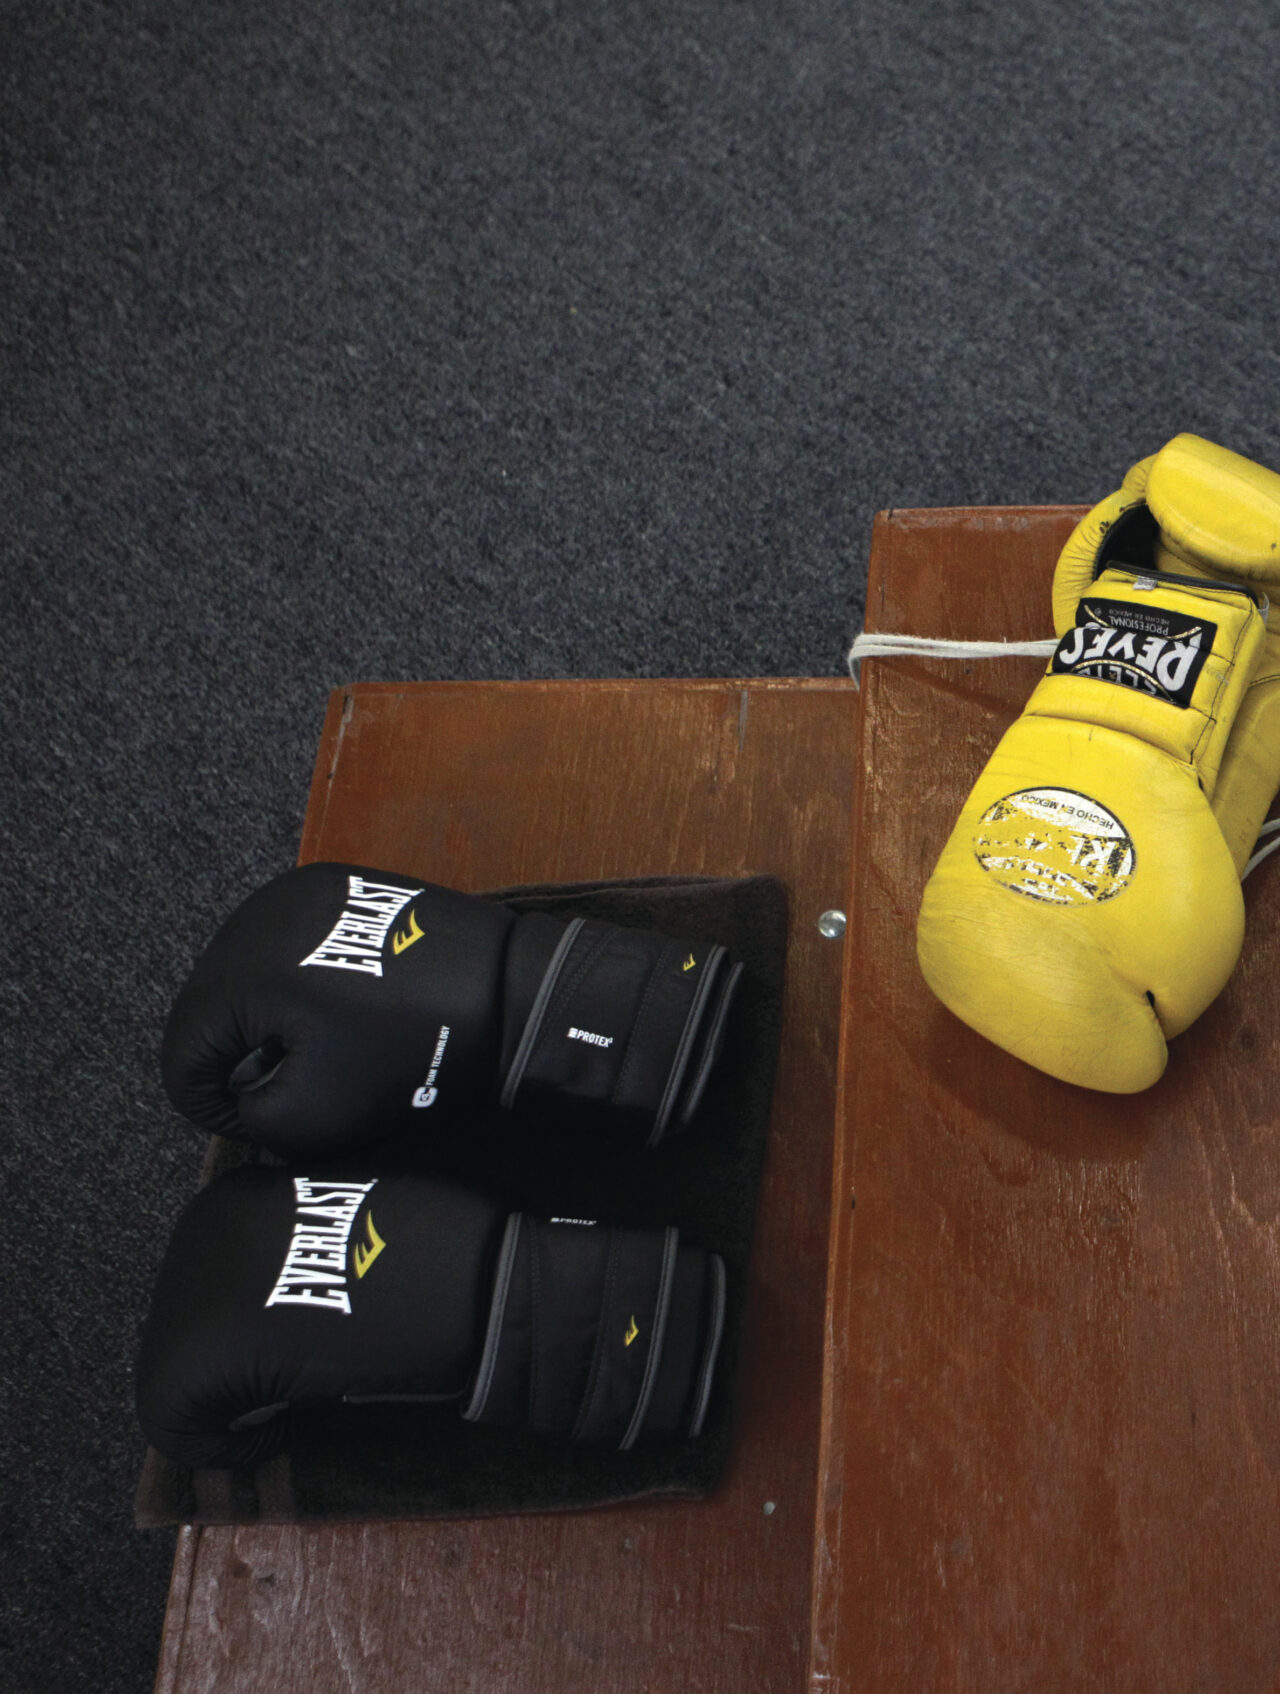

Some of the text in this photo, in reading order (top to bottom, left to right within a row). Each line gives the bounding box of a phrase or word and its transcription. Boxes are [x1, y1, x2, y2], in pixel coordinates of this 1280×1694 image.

[1108, 608, 1170, 625] HECHO EN MEXICO
[1108, 615, 1169, 636] PROFESIONAL
[1058, 622, 1202, 692] REYES
[1020, 795, 1059, 810] MEXICO
[1077, 809, 1115, 830] HECHO
[298, 875, 422, 976] EVERLAST
[430, 1025, 450, 1068] TECHNOLOGY
[424, 1067, 438, 1087] FOAM
[264, 1177, 376, 1315] EVERLAST
